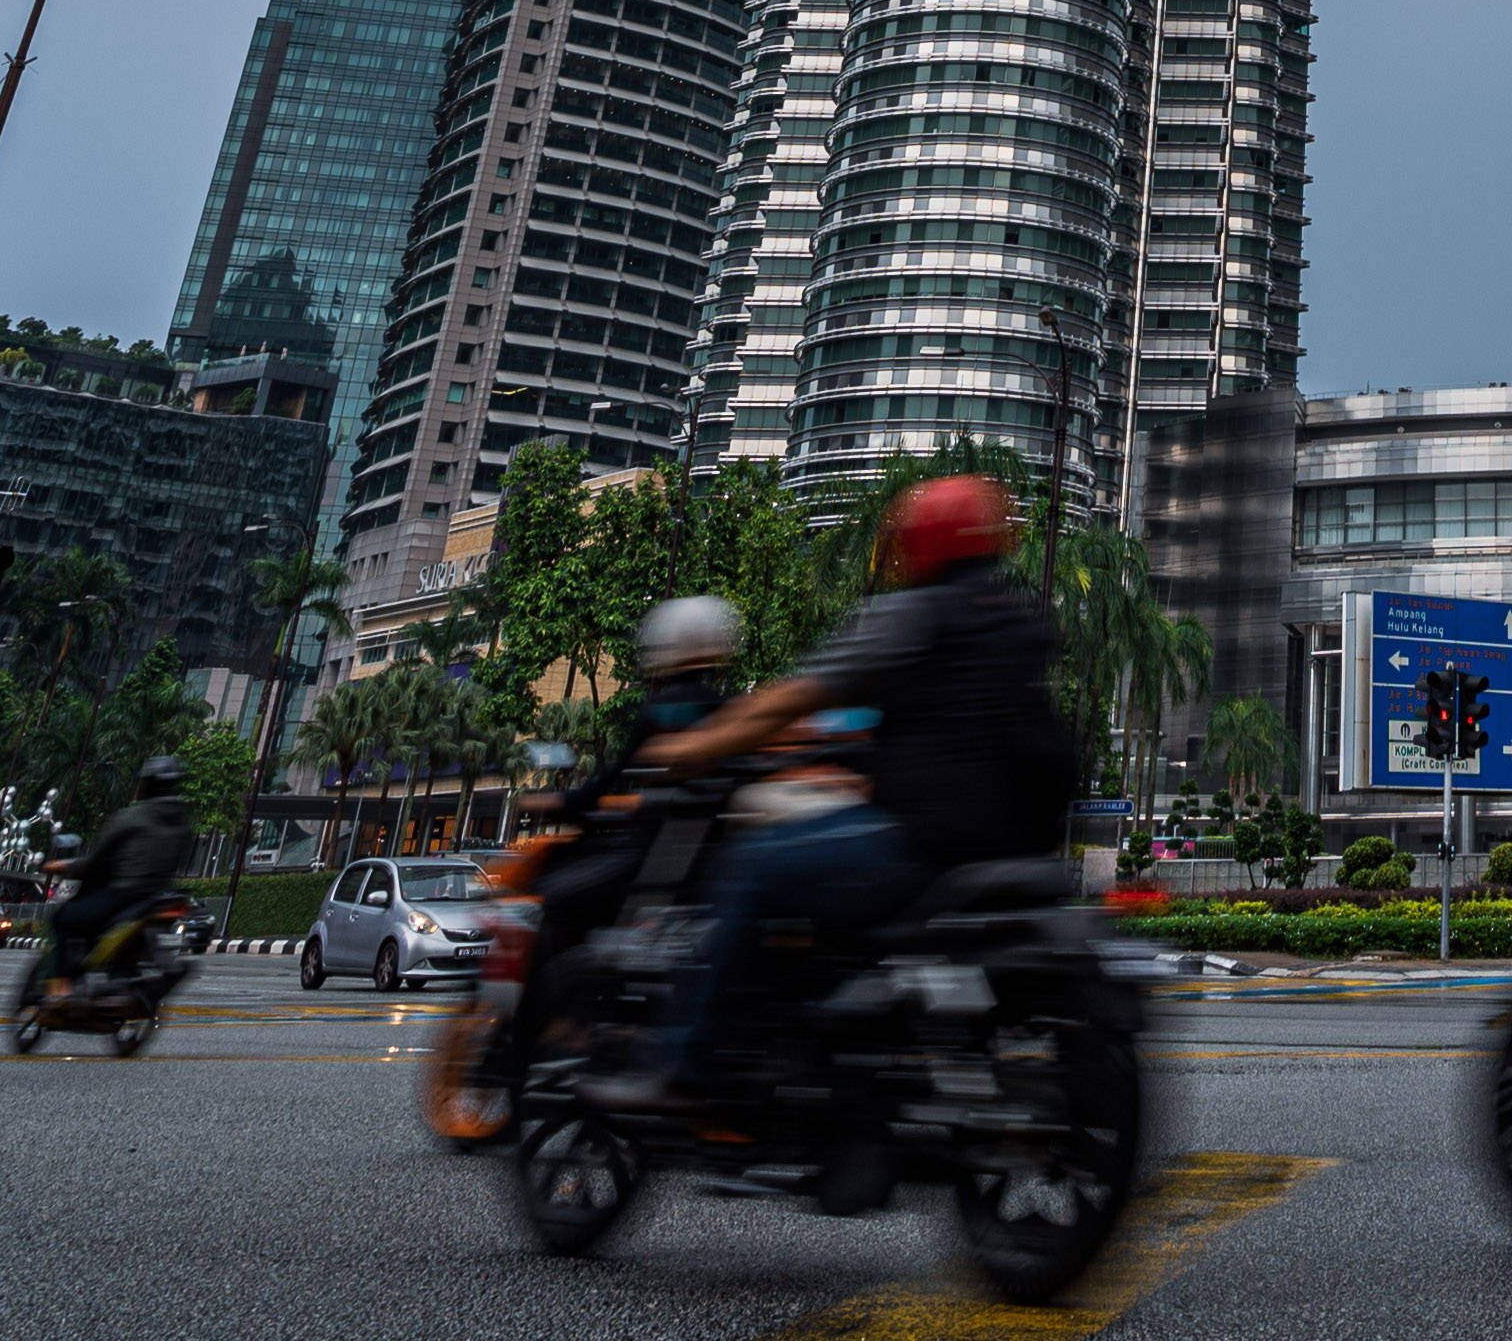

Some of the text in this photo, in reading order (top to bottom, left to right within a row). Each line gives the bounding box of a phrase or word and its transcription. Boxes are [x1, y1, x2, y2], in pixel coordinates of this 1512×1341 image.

[416, 560, 458, 594] SURIA
[1388, 607, 1426, 622] Ampang
[1388, 621, 1444, 637] Hulu Kelang
